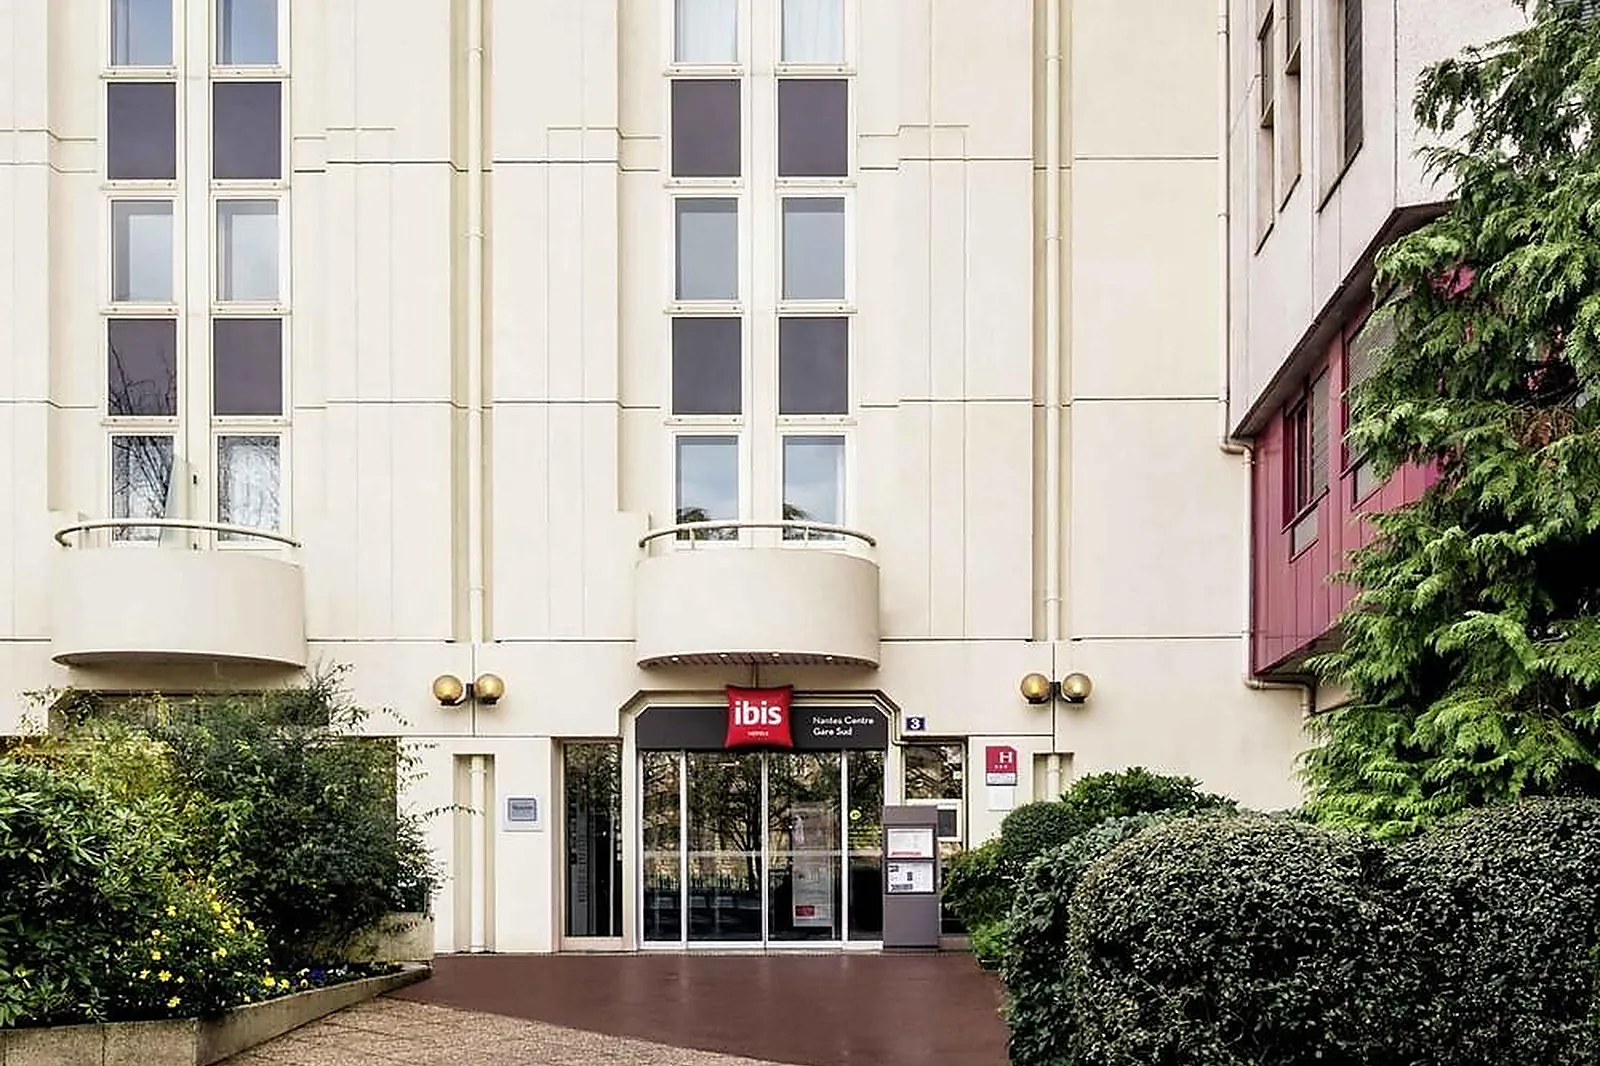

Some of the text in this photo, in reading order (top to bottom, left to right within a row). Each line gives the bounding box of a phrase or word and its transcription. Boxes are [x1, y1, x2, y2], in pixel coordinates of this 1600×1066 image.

[735, 701, 782, 725] ibis
[812, 716, 874, 724] Nantes Centre
[910, 718, 920, 730] 3
[812, 727, 852, 736] Gare Sud
[1000, 752, 1012, 763] H
